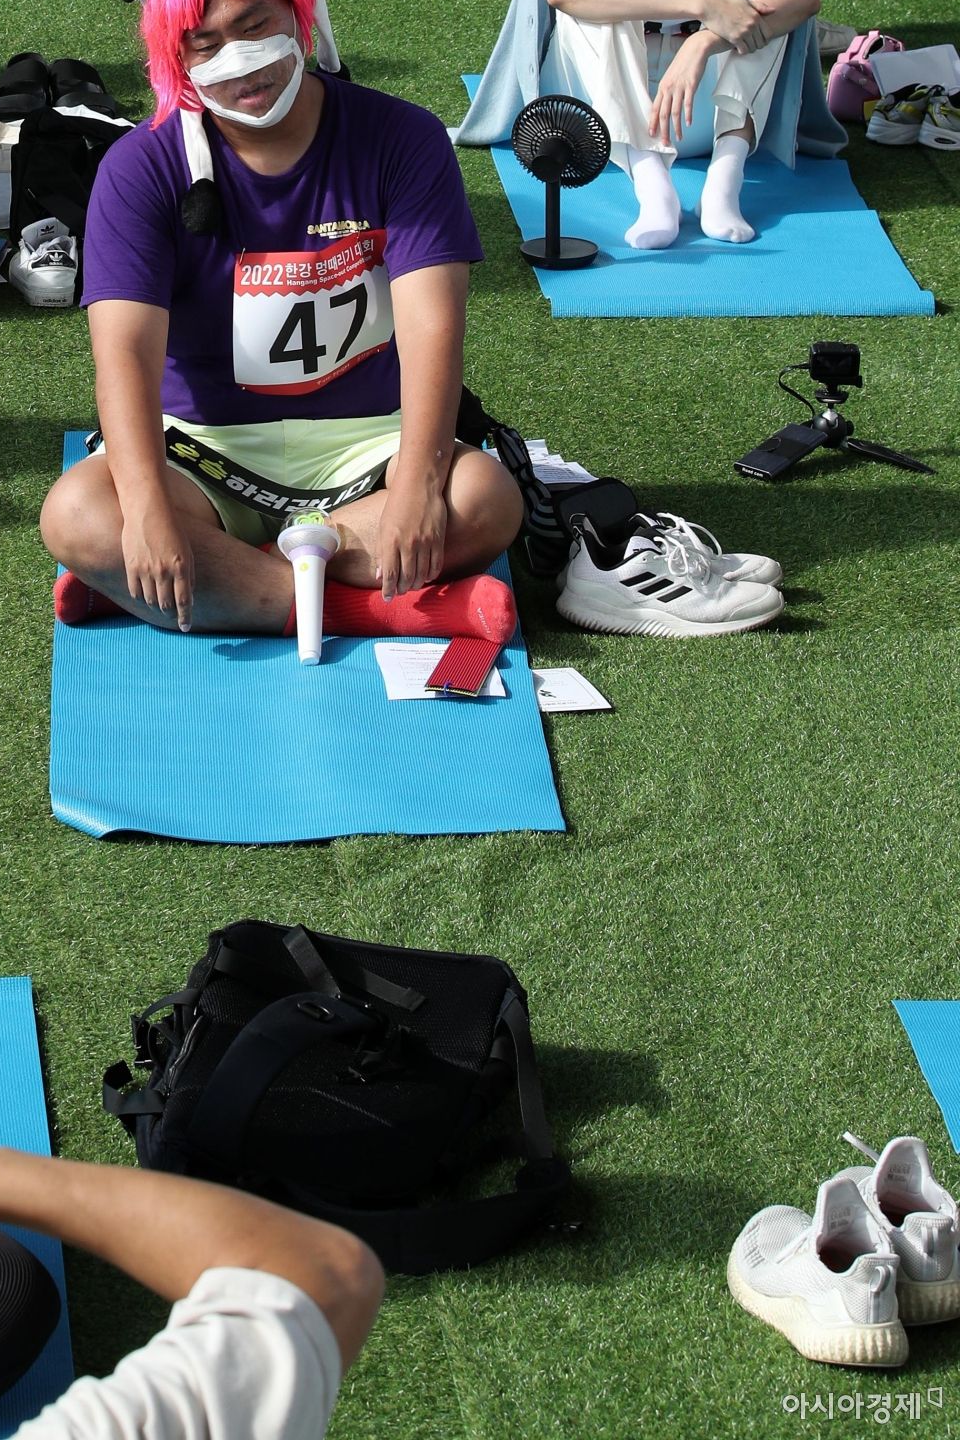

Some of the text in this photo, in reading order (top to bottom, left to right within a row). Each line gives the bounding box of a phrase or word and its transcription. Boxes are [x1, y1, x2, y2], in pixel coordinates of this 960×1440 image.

[240, 239, 374, 286] 2022 한강 멍때리기 대회
[268, 282, 368, 375] 47
